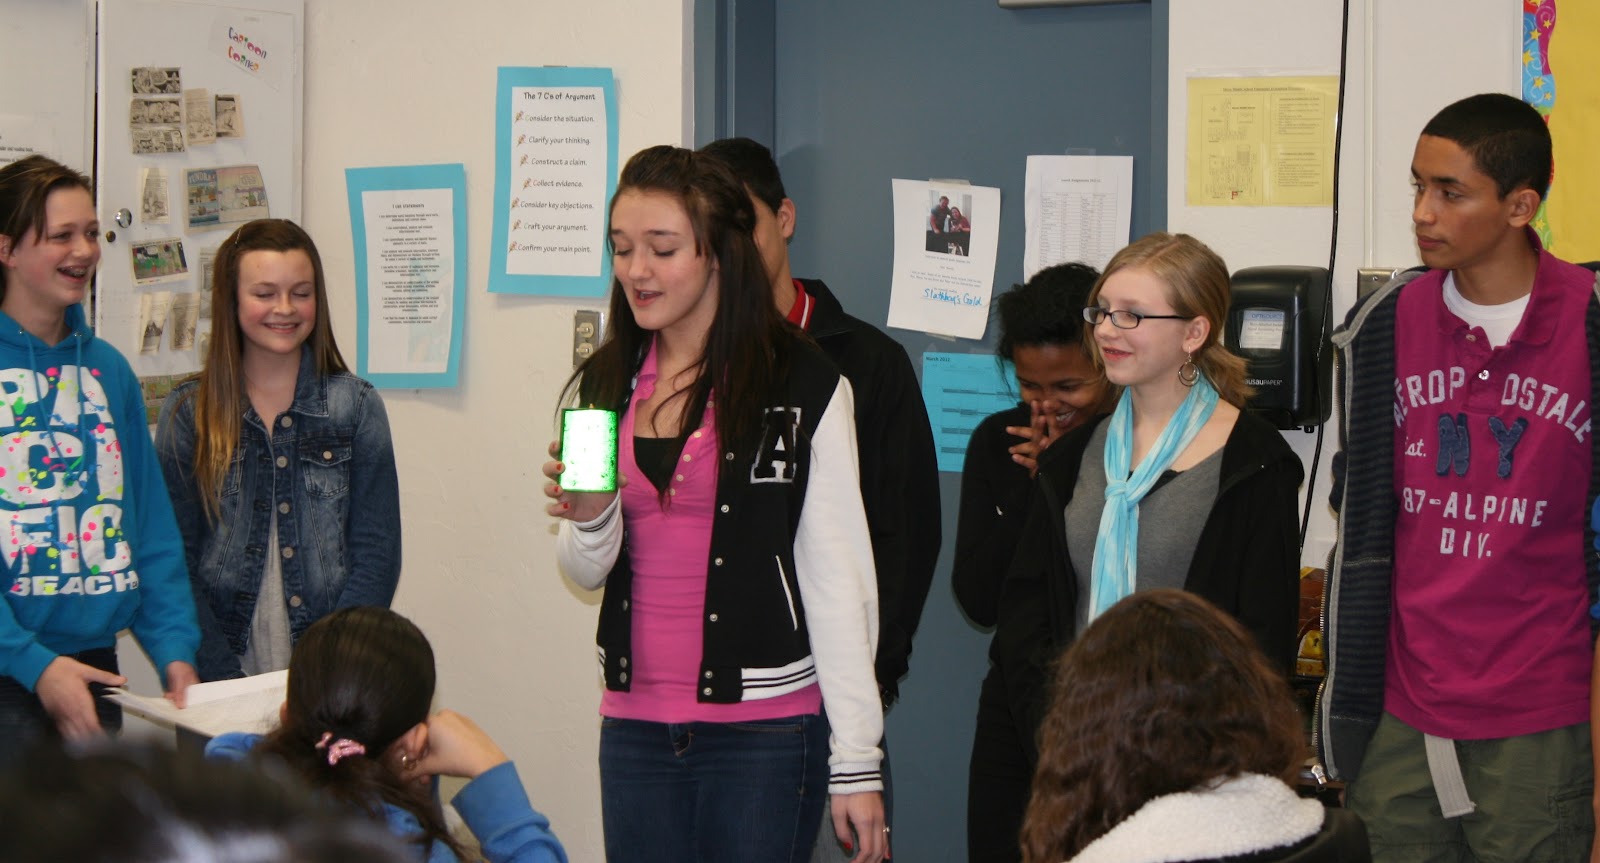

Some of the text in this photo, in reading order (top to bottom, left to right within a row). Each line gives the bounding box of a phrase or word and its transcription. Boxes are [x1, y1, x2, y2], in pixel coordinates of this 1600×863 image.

[524, 92, 536, 100] The
[537, 92, 542, 100] 7
[555, 92, 562, 100] of
[565, 93, 596, 102] Argument
[525, 114, 553, 122] Consider
[528, 136, 549, 145] Clarify
[549, 138, 564, 146] your
[531, 158, 563, 166] Construct
[569, 158, 588, 166] claim.
[532, 179, 584, 188] Collect evidence.
[548, 201, 560, 210] key
[560, 201, 594, 211] objections.
[523, 222, 541, 230] Craft
[556, 224, 588, 232] argument.
[573, 246, 592, 254] point.
[0, 364, 115, 428] PA
[749, 405, 803, 485] A
[1404, 437, 1427, 458] st.
[1439, 527, 1492, 560] DIV.
[9, 570, 140, 597] BEACH
